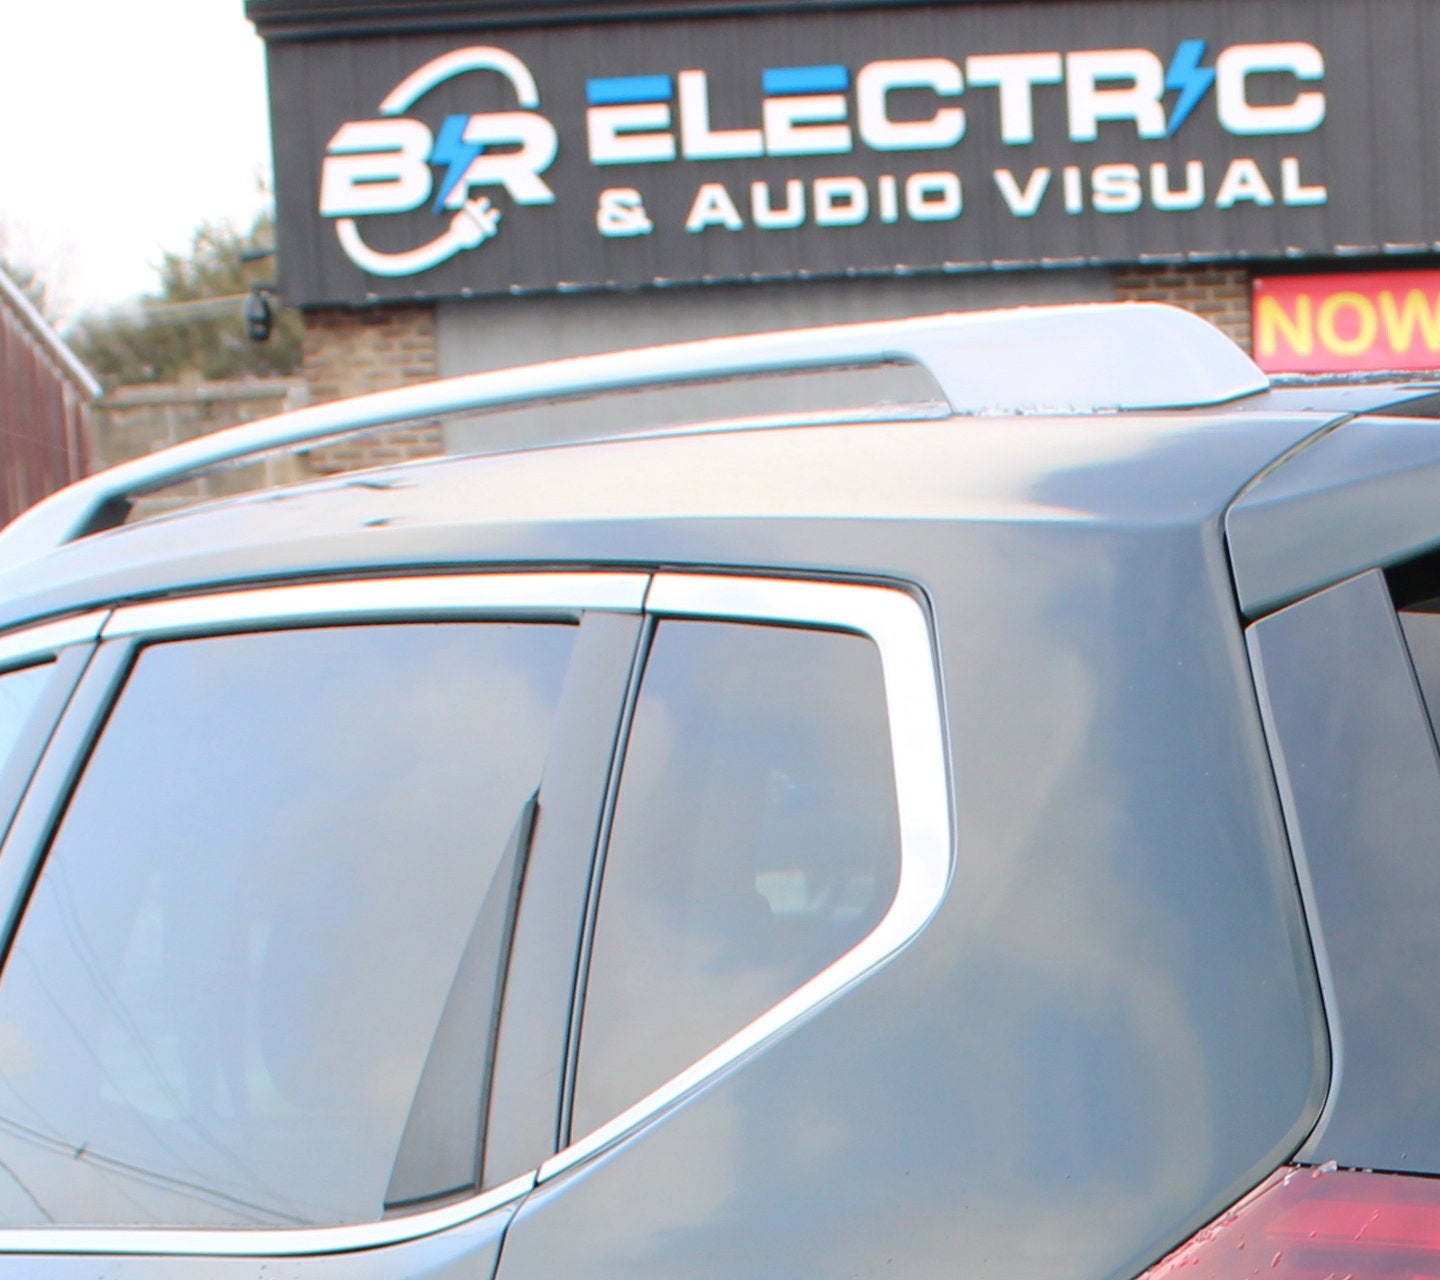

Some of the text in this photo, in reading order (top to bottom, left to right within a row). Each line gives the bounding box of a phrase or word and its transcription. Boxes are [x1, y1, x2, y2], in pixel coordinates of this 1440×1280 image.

[596, 157, 1327, 236] & AUDIO VISUAL
